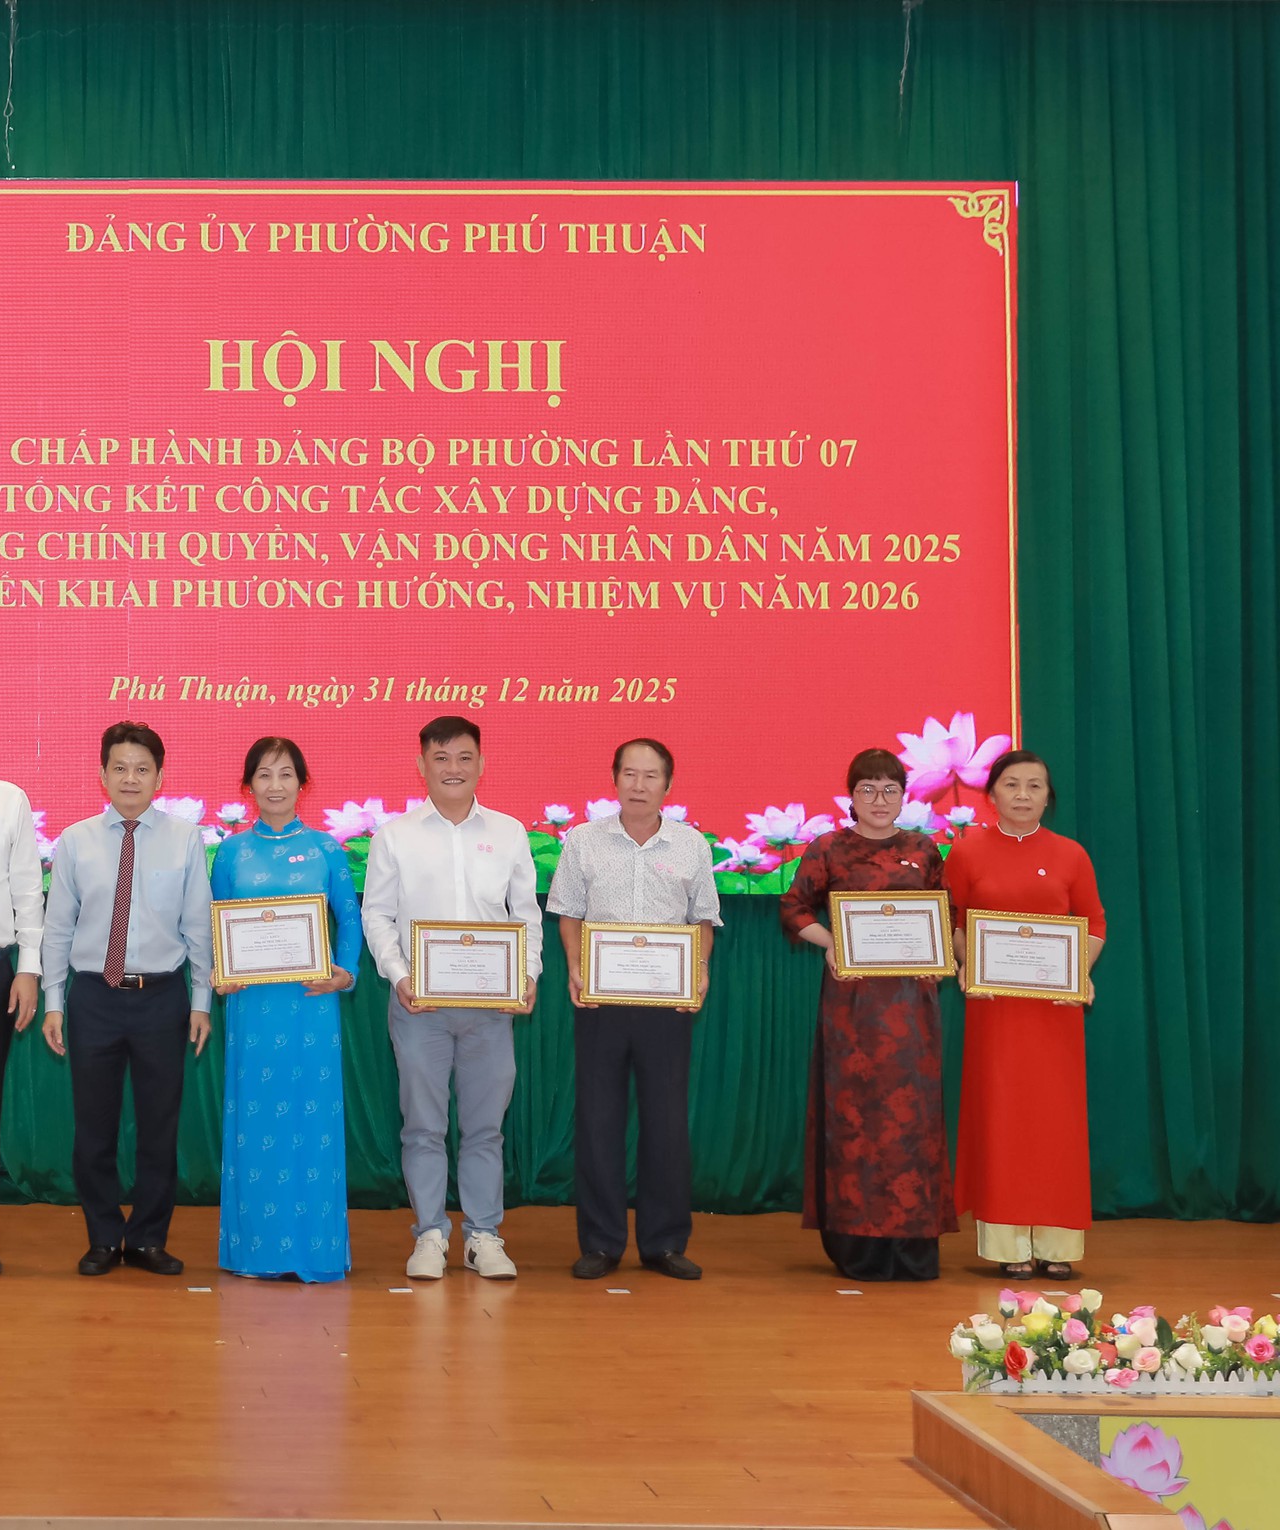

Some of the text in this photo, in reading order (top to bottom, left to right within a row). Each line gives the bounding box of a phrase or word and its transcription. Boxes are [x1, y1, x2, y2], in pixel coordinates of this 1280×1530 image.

[66, 213, 707, 262] ĐẢNG ỦY PHƯỜNG PHÚ THUẬN
[204, 330, 567, 408] HỘI NGHỊ
[10, 429, 120, 465] CHẤP
[129, 430, 243, 465] HÀNH
[255, 430, 368, 466] ĐẢNG
[382, 434, 435, 474] BỘ
[448, 430, 619, 467] PHƯỜNG
[632, 431, 710, 467] LẦN
[721, 431, 811, 467] THỨ
[819, 438, 858, 468] 07
[125, 476, 205, 513] KẾT
[215, 476, 330, 513] CÔNG
[341, 477, 422, 514] TÁC
[433, 477, 516, 514] XÂY
[526, 481, 643, 522] DỰNG
[654, 478, 779, 518] ĐẢNG,
[37, 523, 167, 560] CHÍNH
[178, 524, 329, 567] QUYỀN,
[339, 528, 420, 569] VẬN
[433, 528, 549, 569] ĐỘNG
[561, 525, 673, 562] NHÂN
[685, 525, 770, 562] DÂN
[780, 527, 872, 563] NĂM
[883, 533, 961, 563] 2025
[57, 579, 159, 608] KHAI
[172, 575, 344, 609] PHƯƠNG
[356, 572, 516, 614] HƯỚNG,
[526, 576, 661, 618] NHIỆM
[671, 580, 726, 618] VỤ
[739, 575, 830, 610] NĂM
[842, 580, 920, 611] 2026
[108, 675, 678, 708] Phú Thuận, ngày 31 tháng 12 năm 2025
